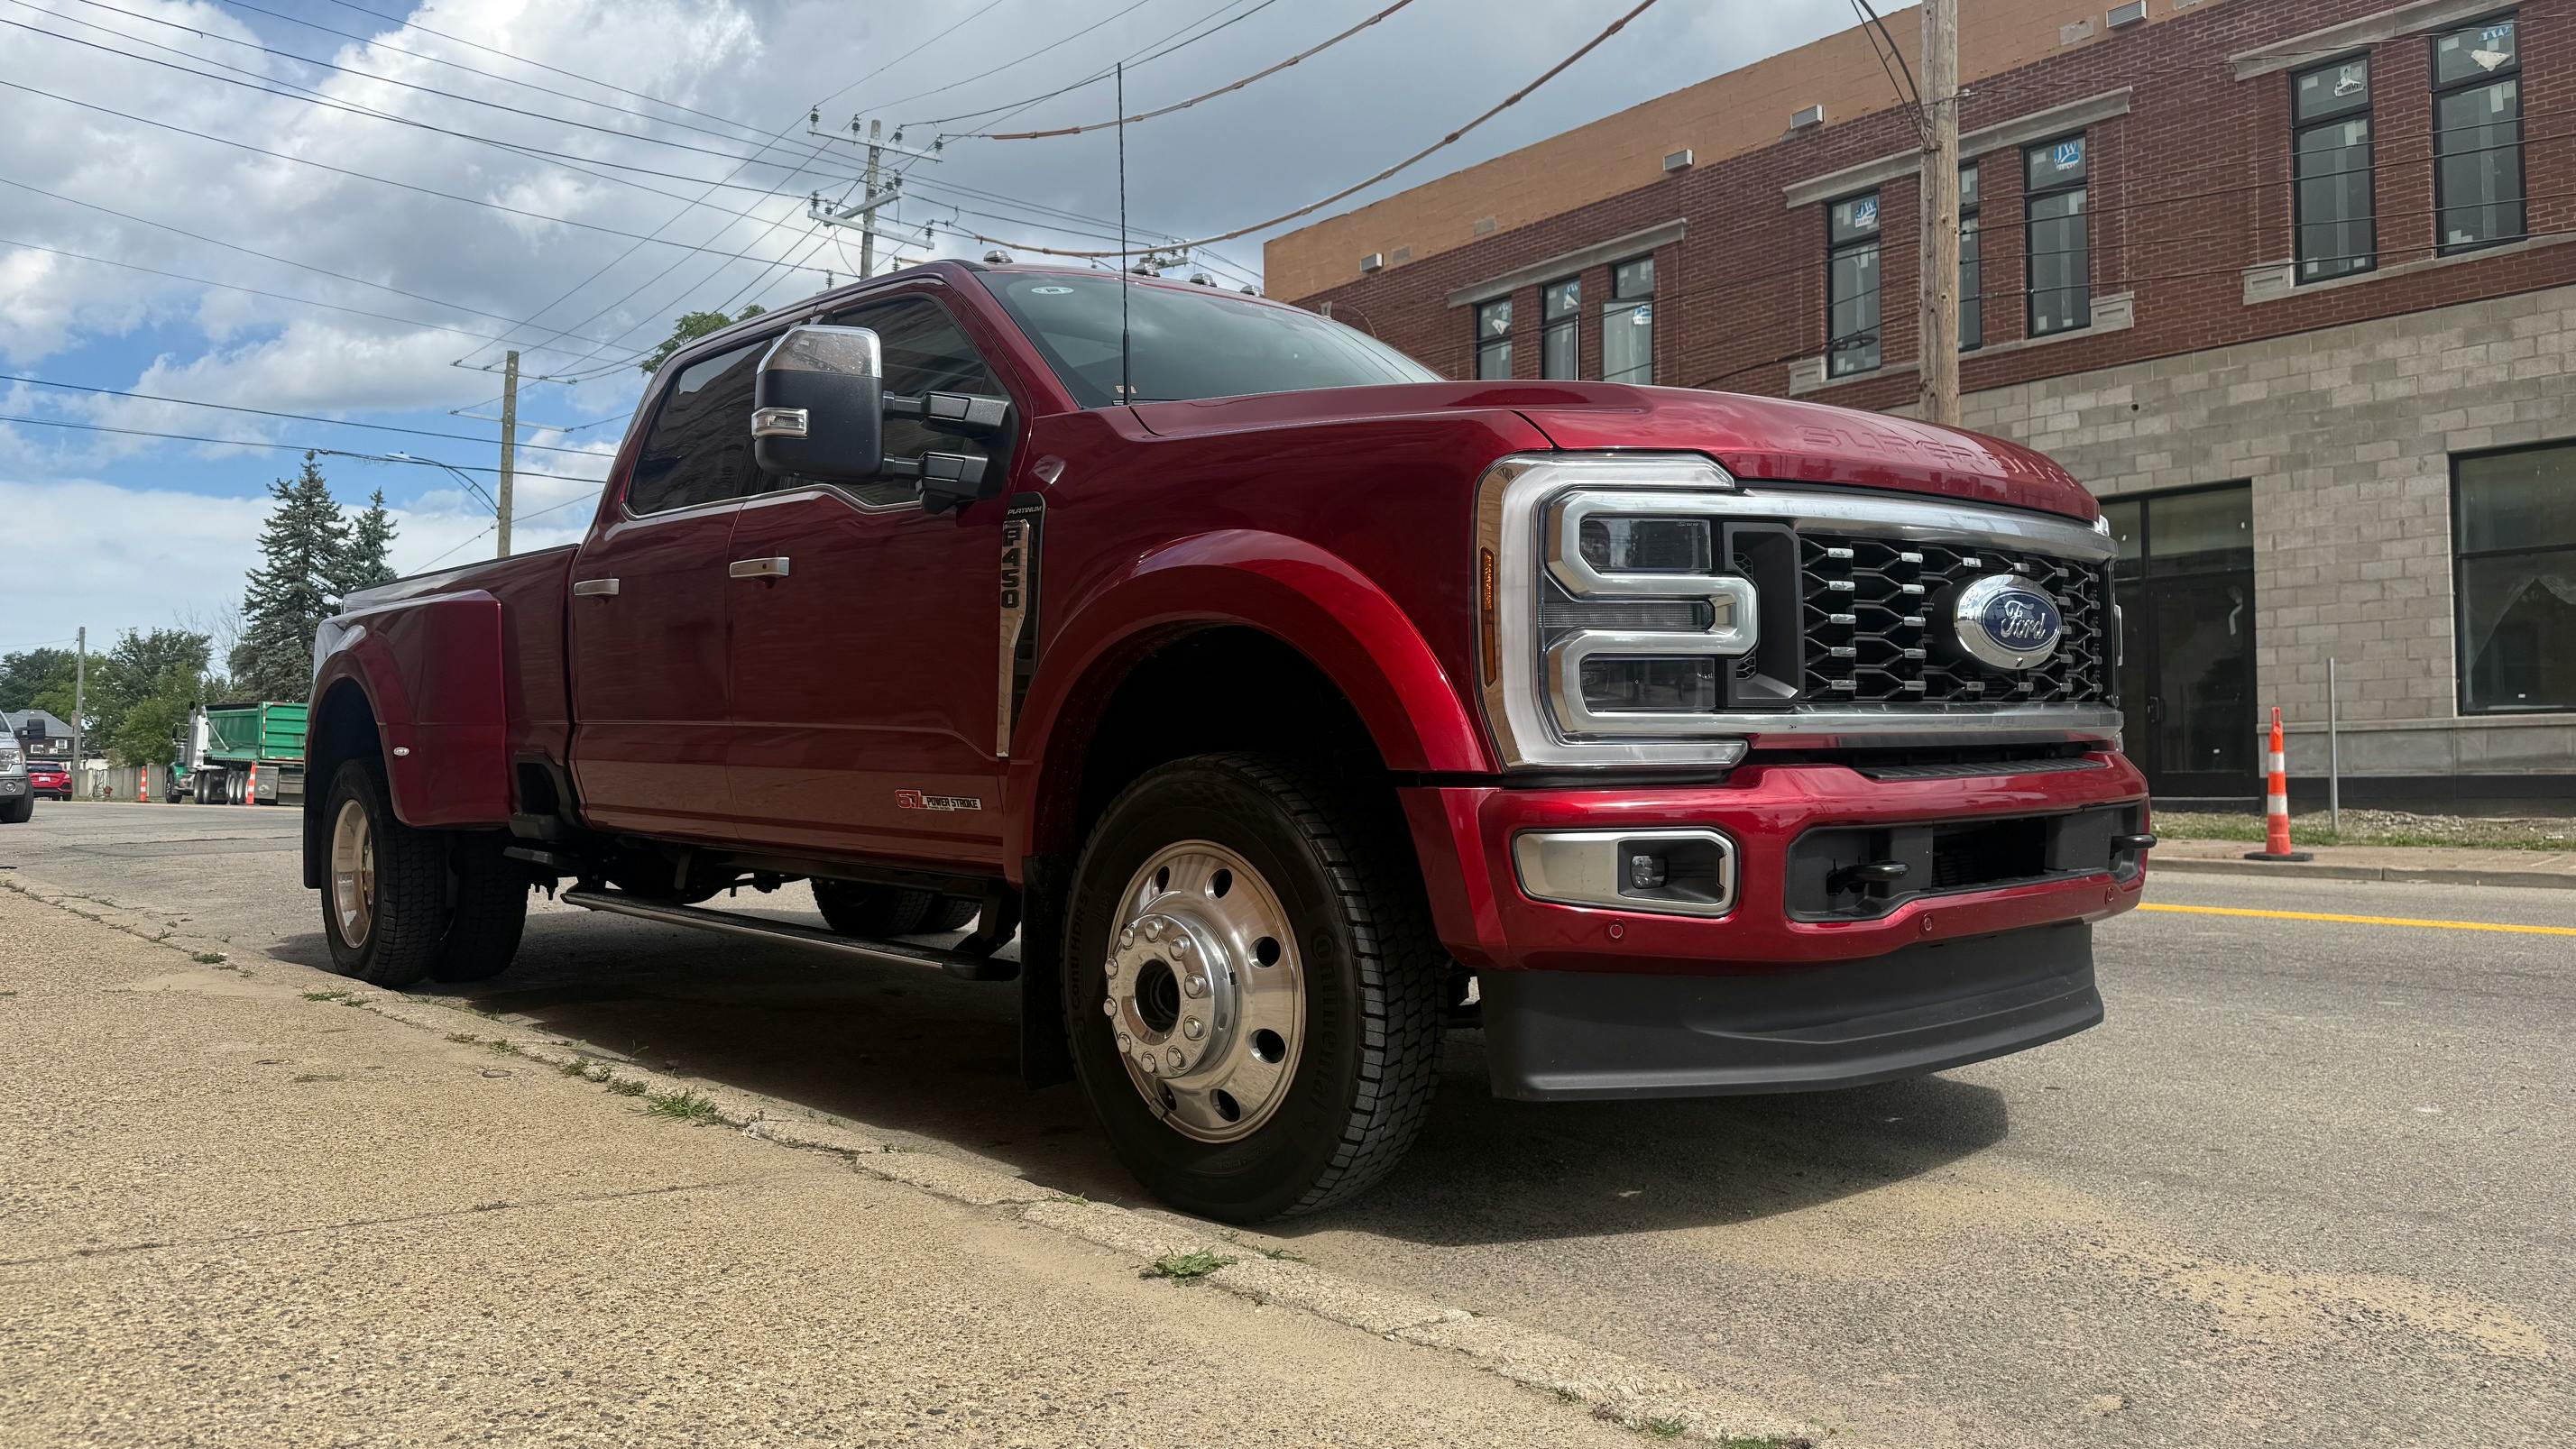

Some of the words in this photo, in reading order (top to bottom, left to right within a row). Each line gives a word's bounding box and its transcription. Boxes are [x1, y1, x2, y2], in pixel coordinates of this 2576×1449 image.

[1007, 505, 1042, 515] PLATINUM
[1001, 526, 1022, 609] F450
[2000, 600, 2047, 640] Ford
[926, 796, 950, 807] POWER
[951, 798, 979, 809] STROKE
